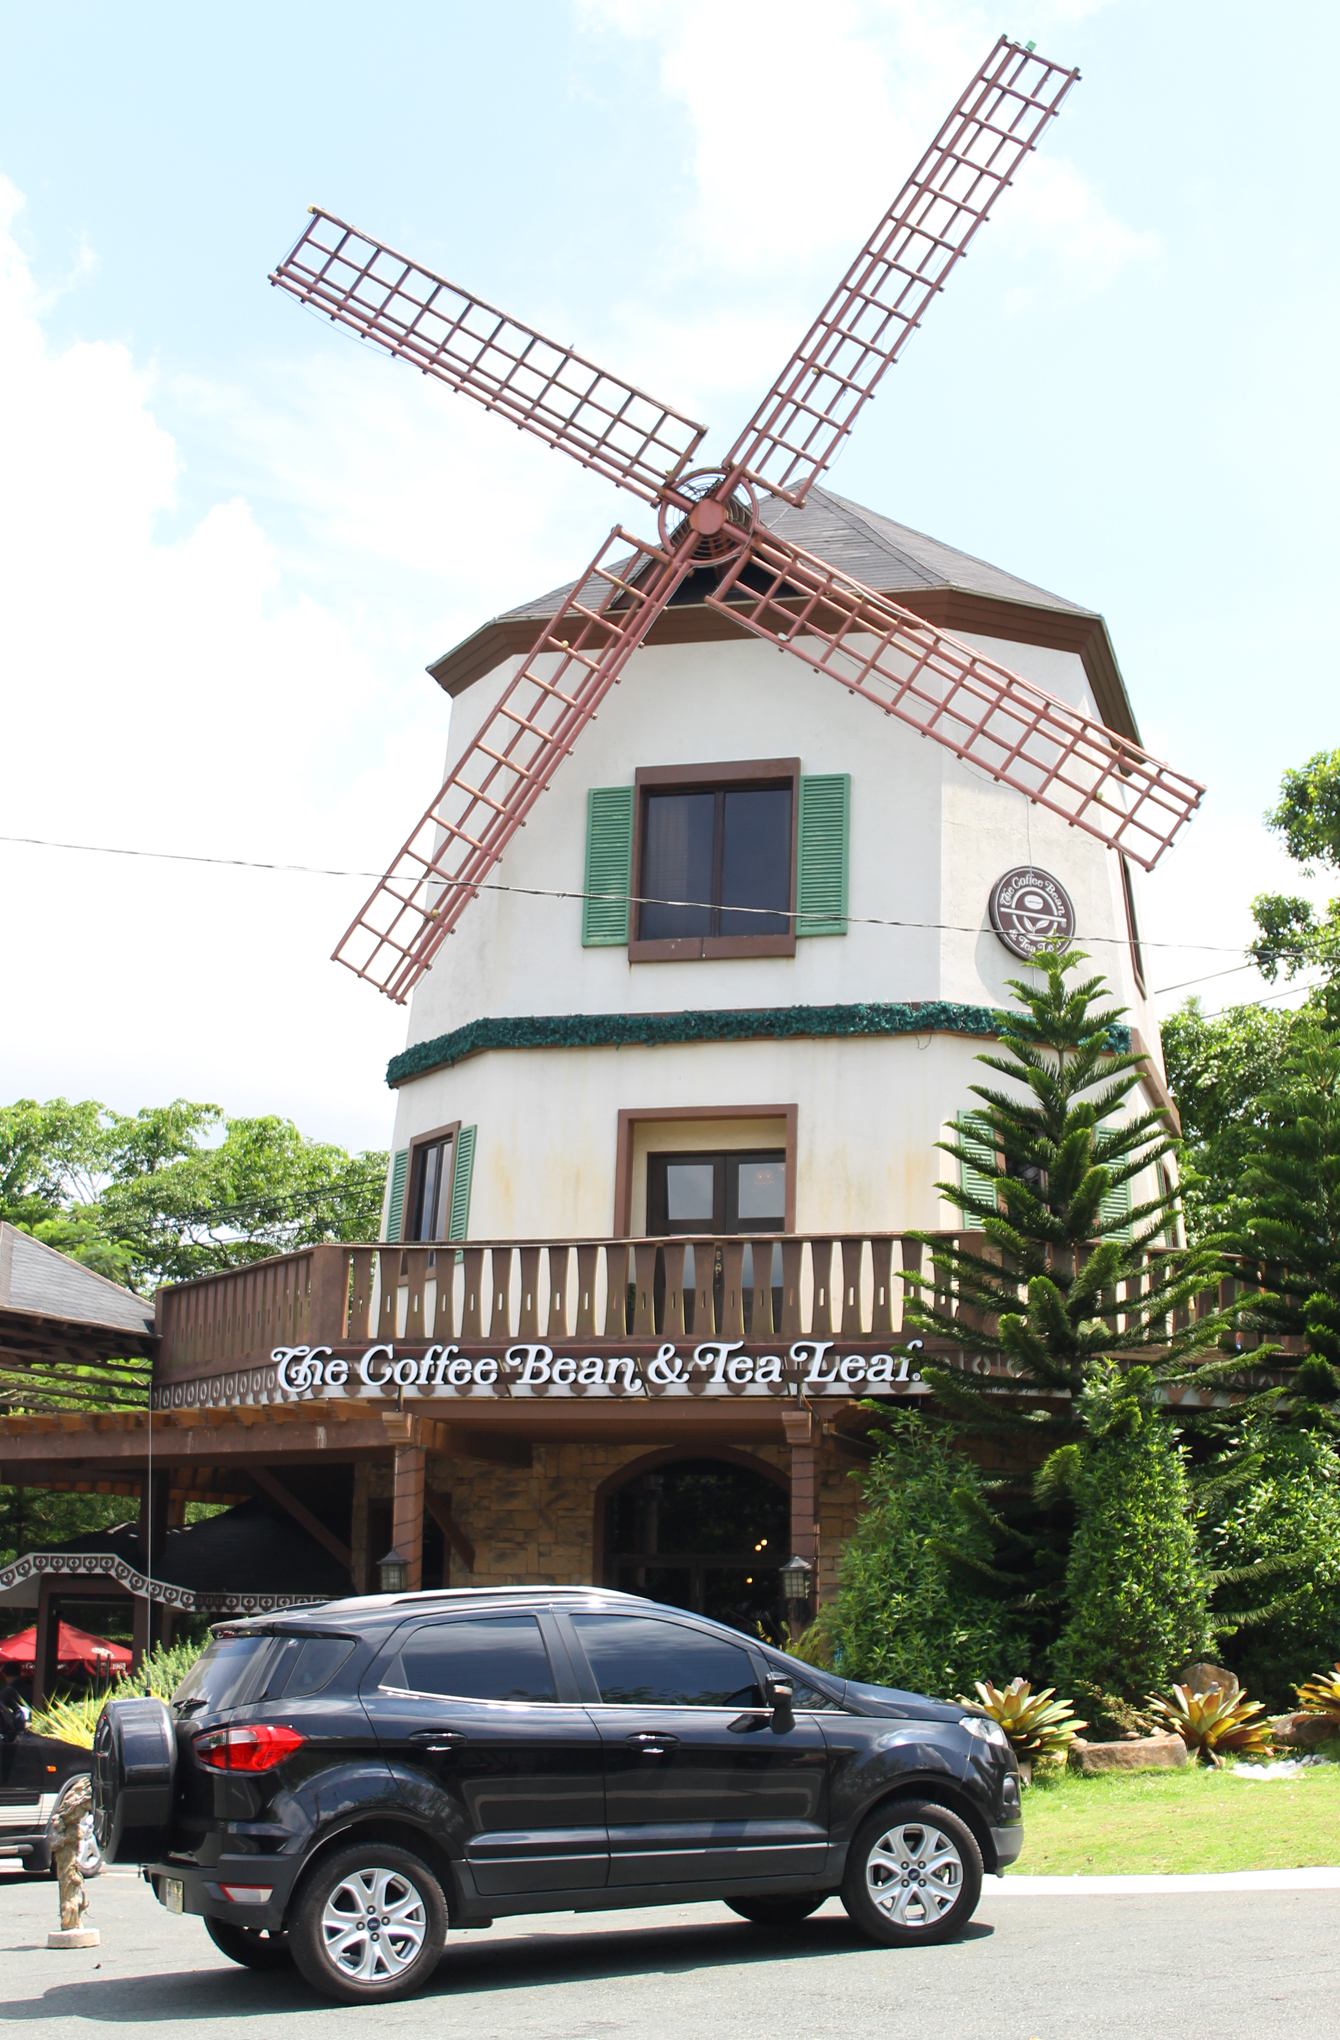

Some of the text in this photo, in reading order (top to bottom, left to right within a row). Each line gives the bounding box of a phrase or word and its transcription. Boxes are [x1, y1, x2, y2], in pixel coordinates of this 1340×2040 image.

[1000, 873, 1066, 916] The Coffee Bean
[1009, 928, 1019, 941] &
[1018, 935, 1037, 953] Tea
[270, 1344, 349, 1393] The
[359, 1343, 499, 1386] Coffee
[505, 1343, 643, 1393] Bean
[647, 1343, 691, 1384] &
[694, 1340, 783, 1384] Tea
